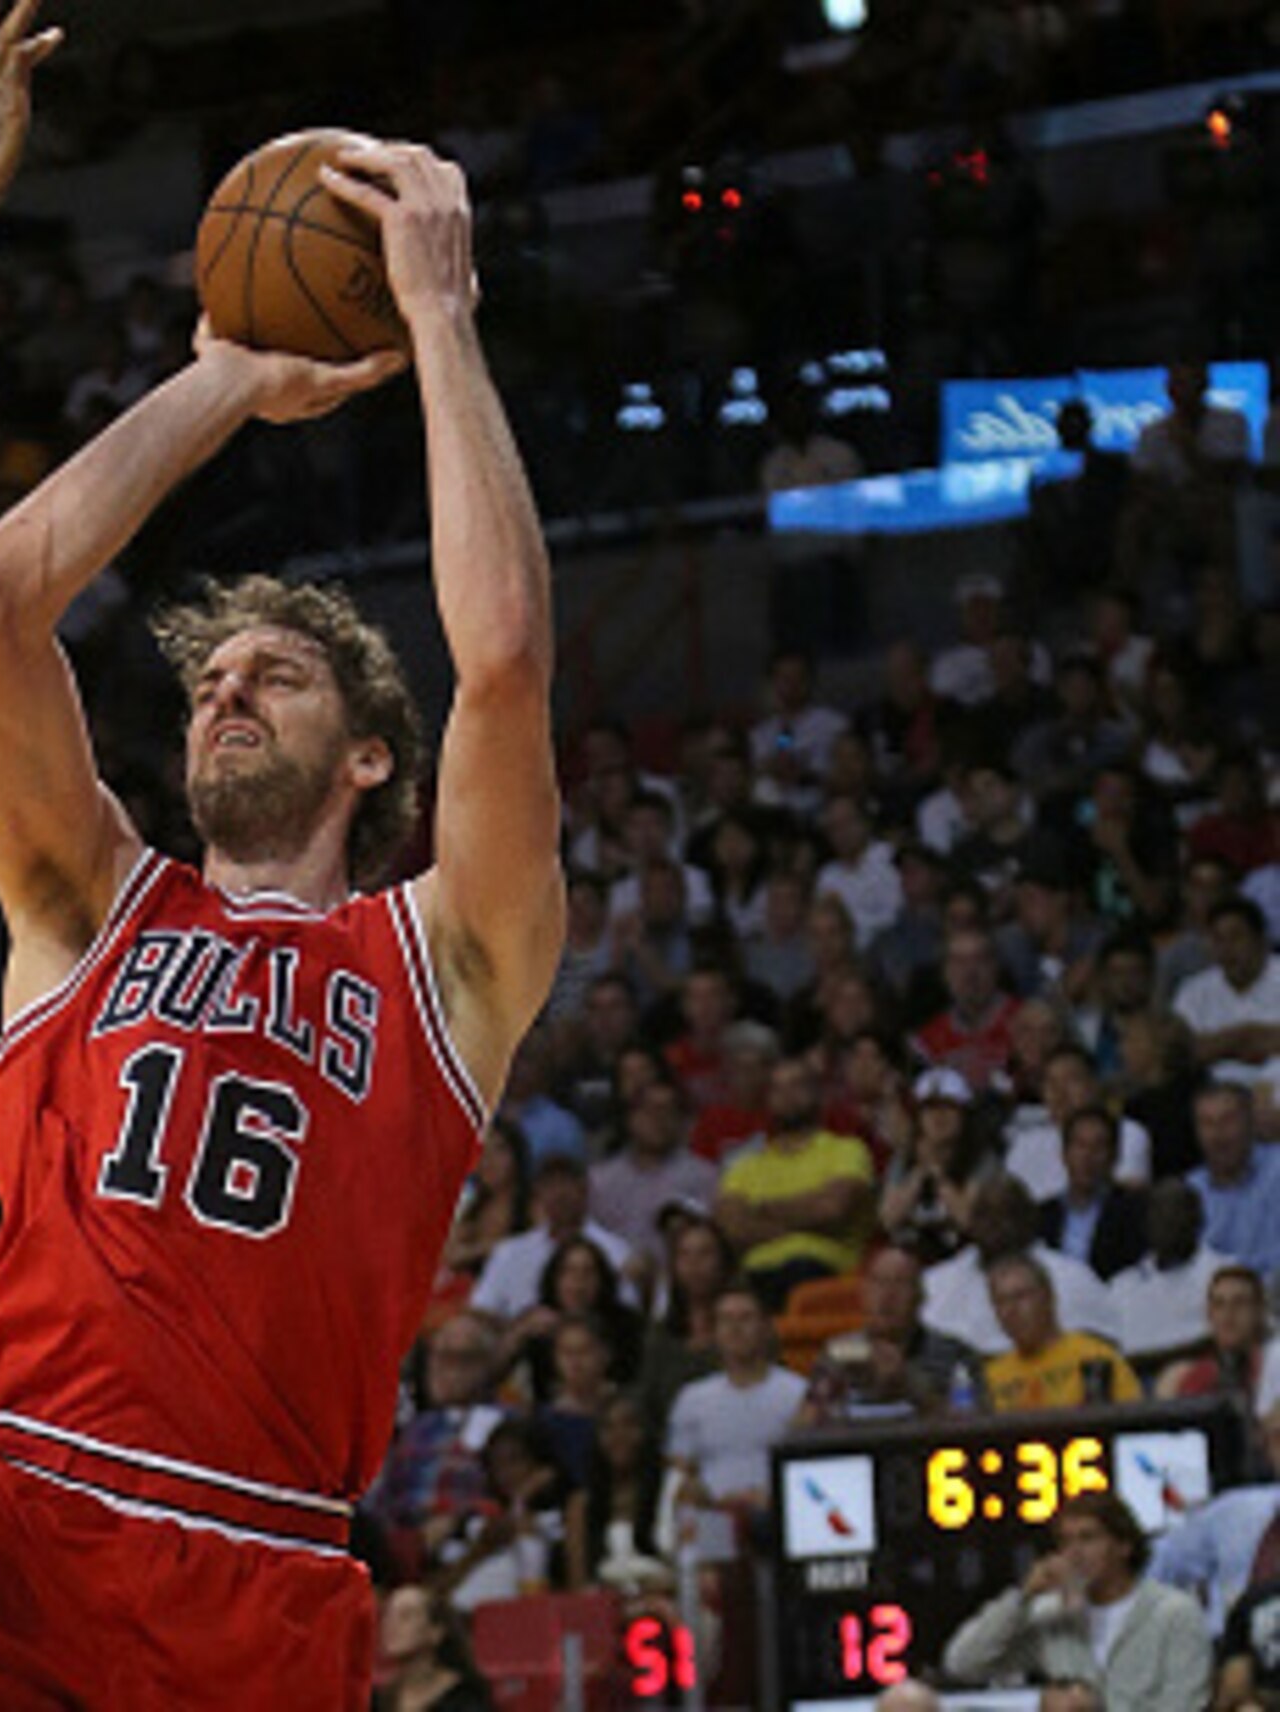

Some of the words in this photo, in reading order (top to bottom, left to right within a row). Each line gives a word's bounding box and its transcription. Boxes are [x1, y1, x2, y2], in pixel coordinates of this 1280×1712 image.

[90, 928, 380, 1103] BULLS
[97, 1042, 310, 1239] 16
[927, 1437, 1108, 1529] 6:36
[625, 1616, 696, 1696] 51
[839, 1603, 911, 1685] 12
